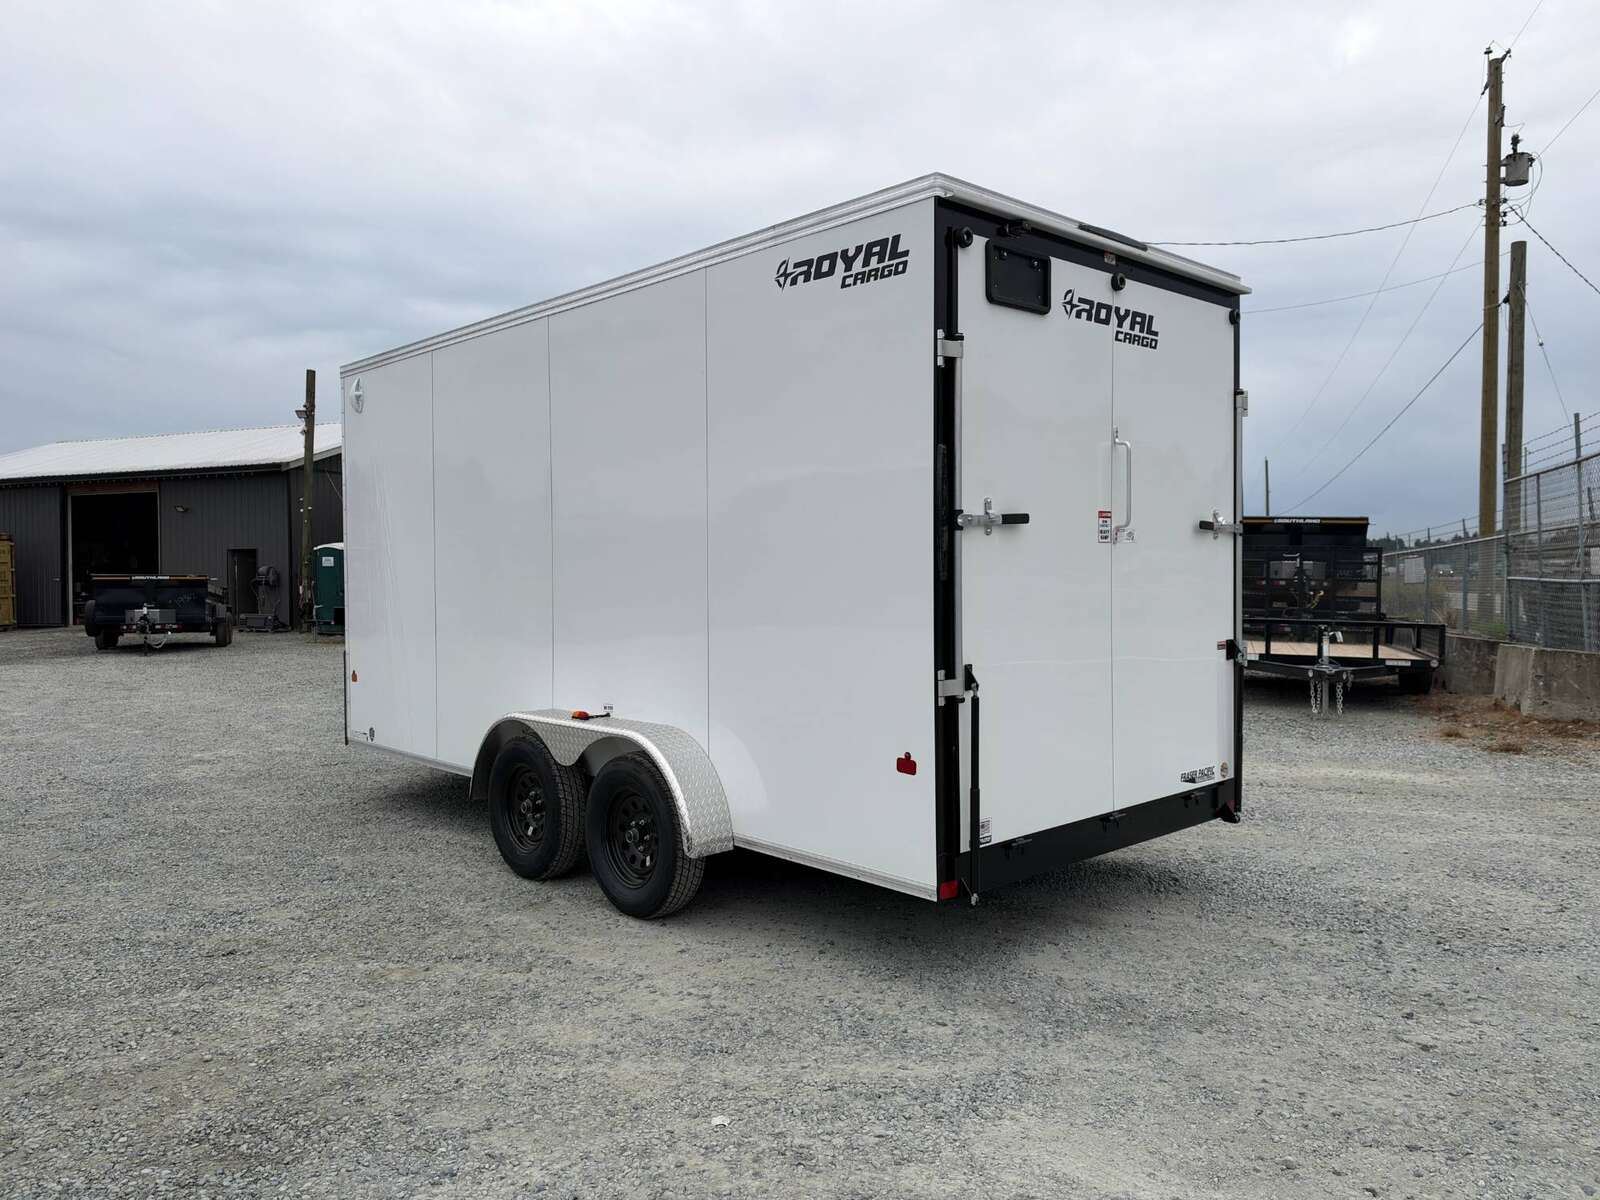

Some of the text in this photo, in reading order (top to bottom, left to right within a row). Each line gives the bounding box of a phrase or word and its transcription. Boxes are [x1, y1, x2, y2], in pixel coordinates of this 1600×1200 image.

[789, 234, 910, 287] ROYAL
[840, 260, 908, 289] CARGO
[1075, 297, 1159, 337] ROYAL
[1115, 330, 1158, 350] CARGO
